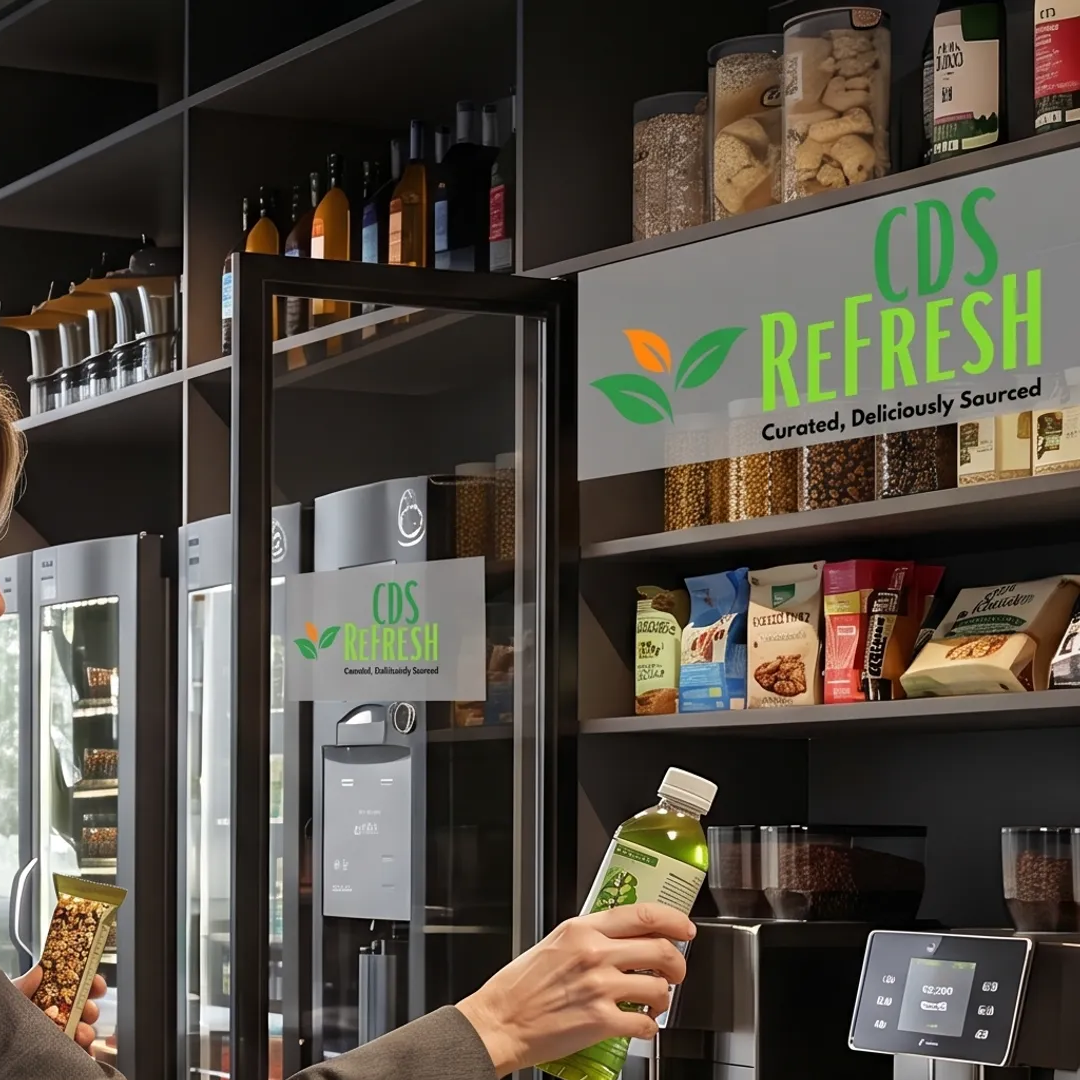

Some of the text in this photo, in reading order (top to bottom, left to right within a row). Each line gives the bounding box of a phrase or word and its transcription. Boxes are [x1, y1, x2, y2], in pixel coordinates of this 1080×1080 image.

[874, 187, 998, 303] CDS
[761, 411, 846, 442] Curated,
[852, 393, 954, 427] Deliciously
[372, 579, 419, 625] CDS
